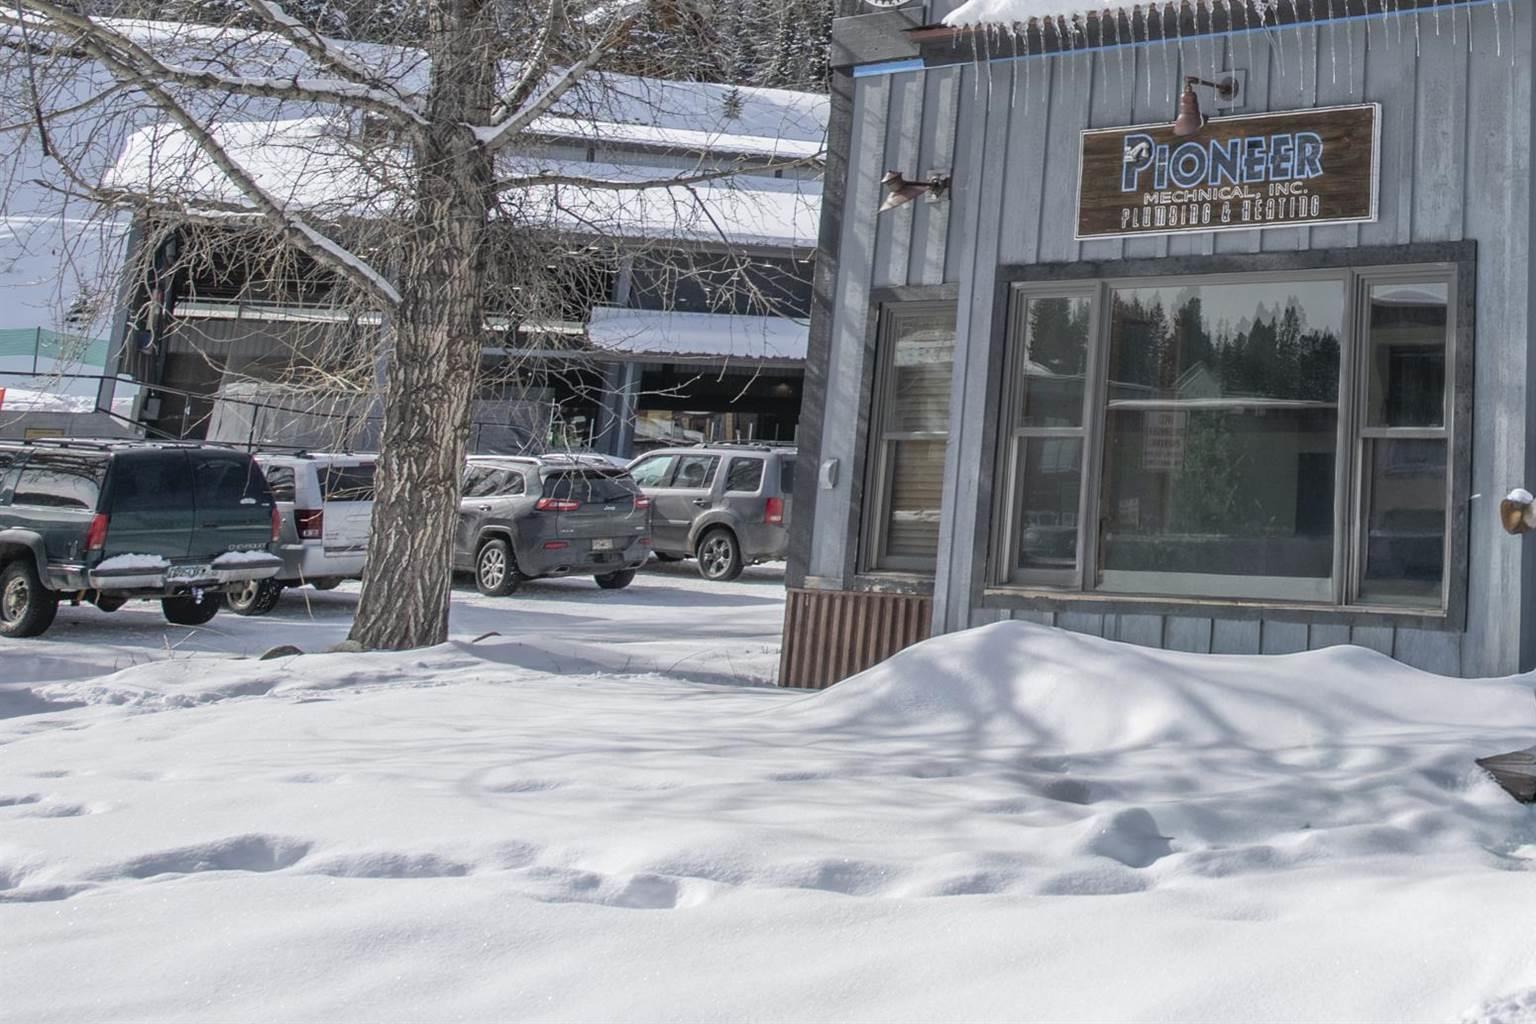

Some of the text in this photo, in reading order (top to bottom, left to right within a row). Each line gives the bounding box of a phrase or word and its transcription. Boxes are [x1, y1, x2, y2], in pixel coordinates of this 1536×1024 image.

[1121, 131, 1324, 193] PIONEER
[1268, 181, 1309, 197] INC.
[1121, 195, 1320, 229] PLUMBING & HEATING
